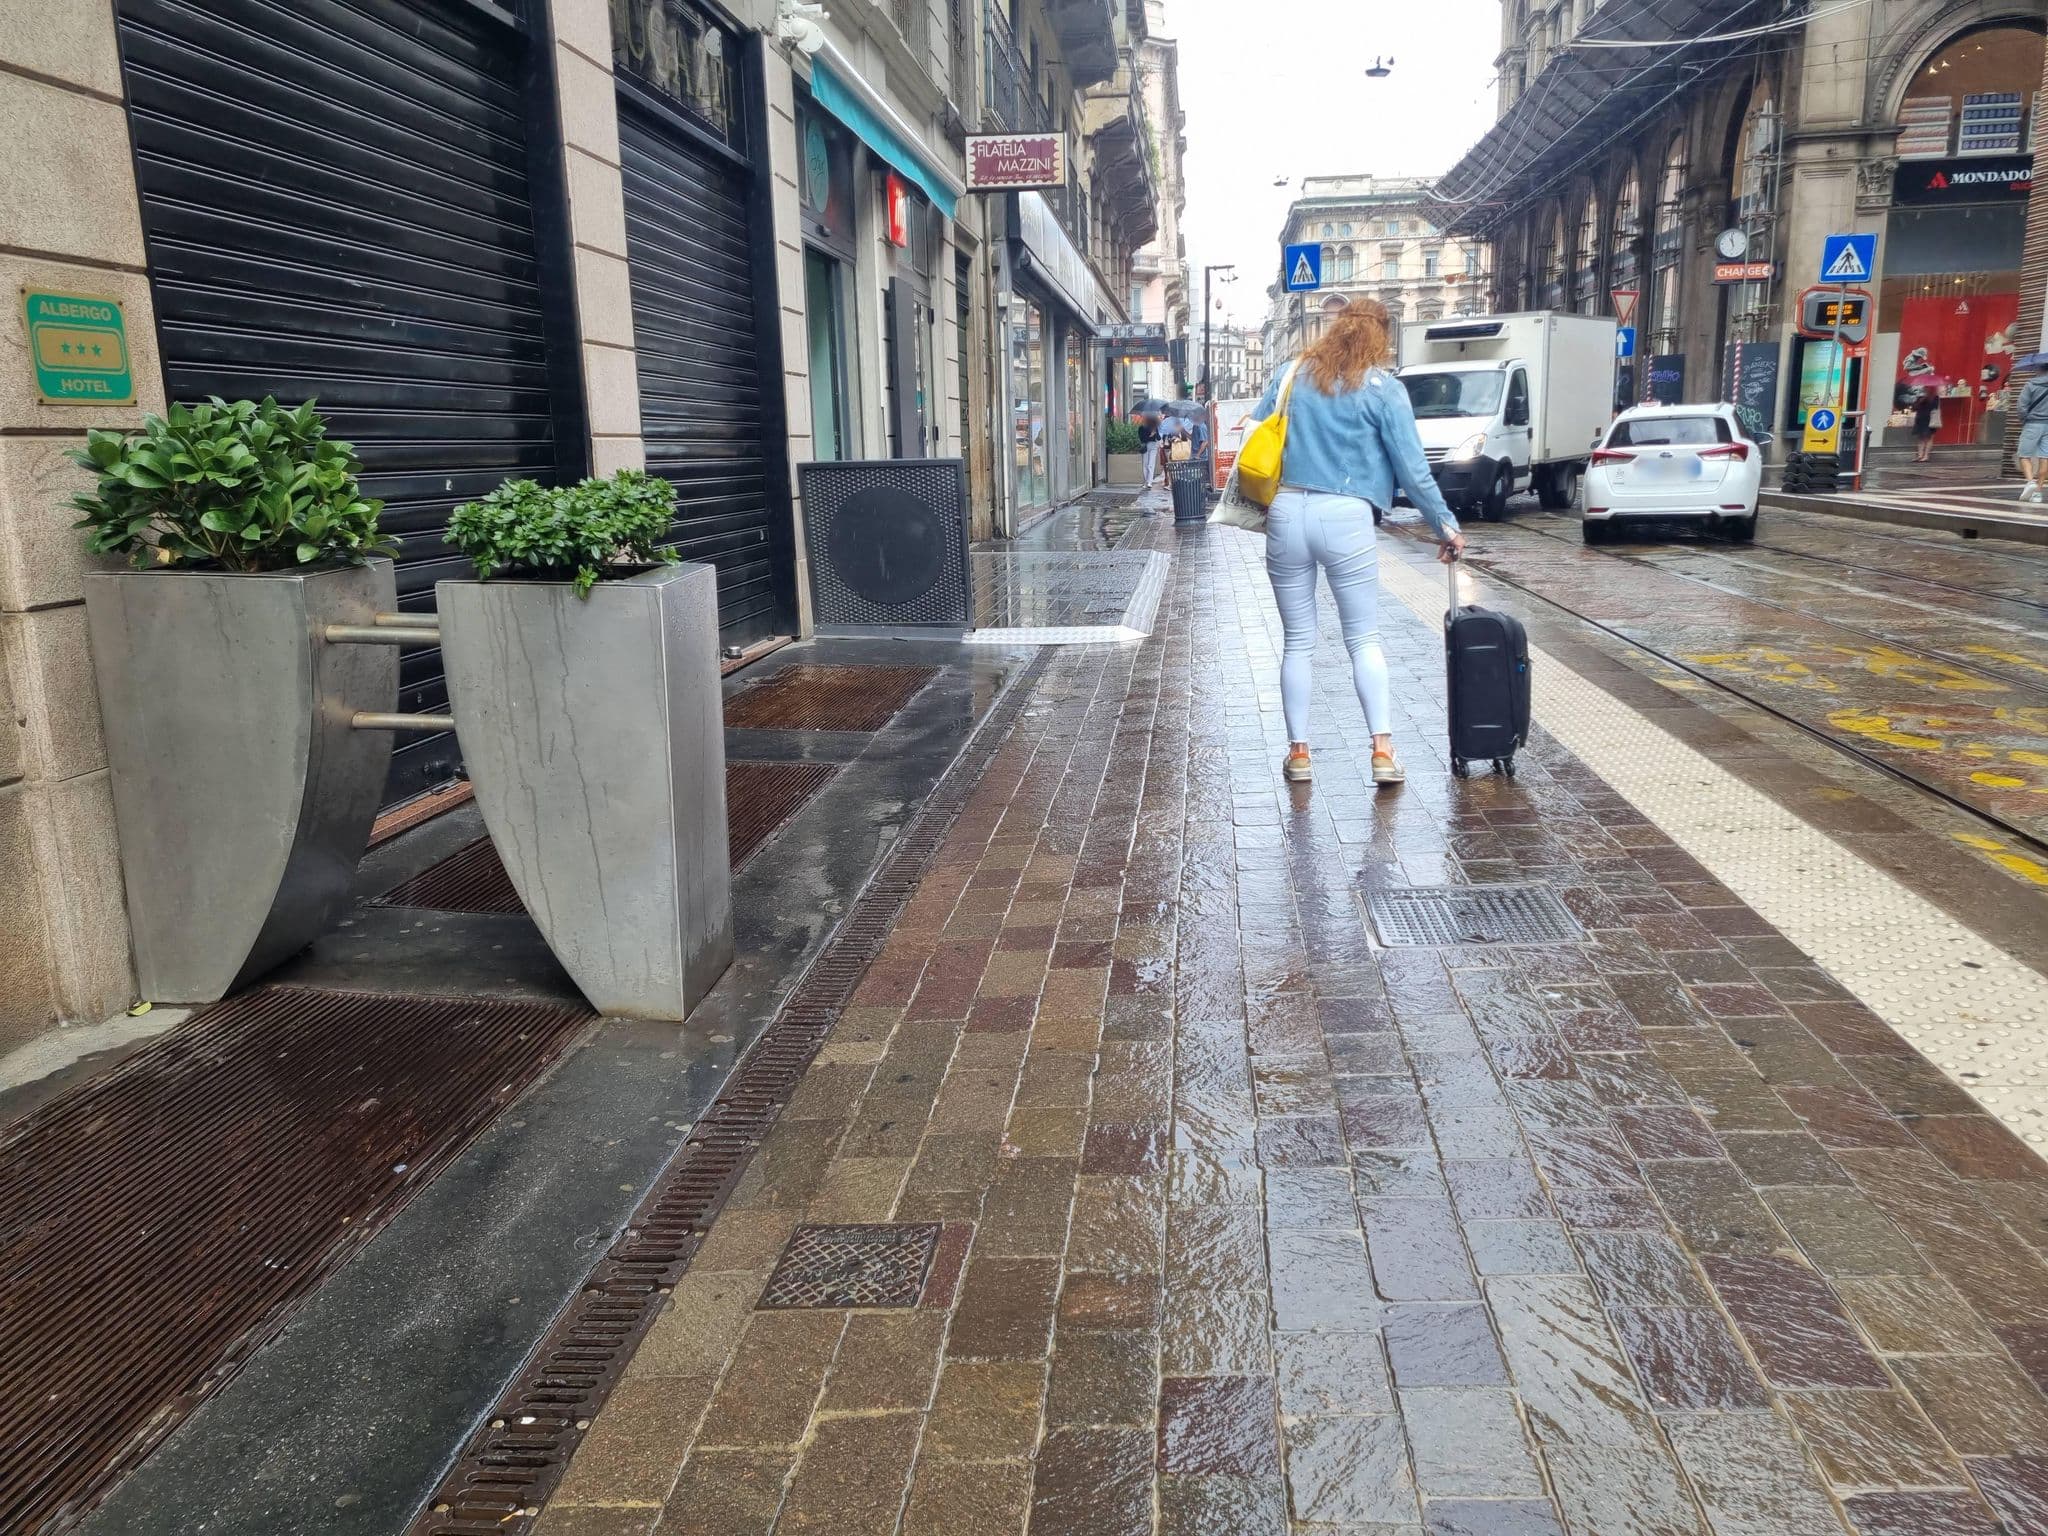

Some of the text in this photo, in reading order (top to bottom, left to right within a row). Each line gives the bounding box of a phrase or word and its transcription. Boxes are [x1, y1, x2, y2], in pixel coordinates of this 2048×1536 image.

[977, 143, 1027, 158] FILATELIA
[997, 157, 1051, 173] MAZZINI
[1949, 168, 2034, 185] MONDADO
[1717, 266, 1762, 278] CHANGE
[40, 300, 113, 322] ALBERGO
[61, 378, 113, 394] HOTEL
